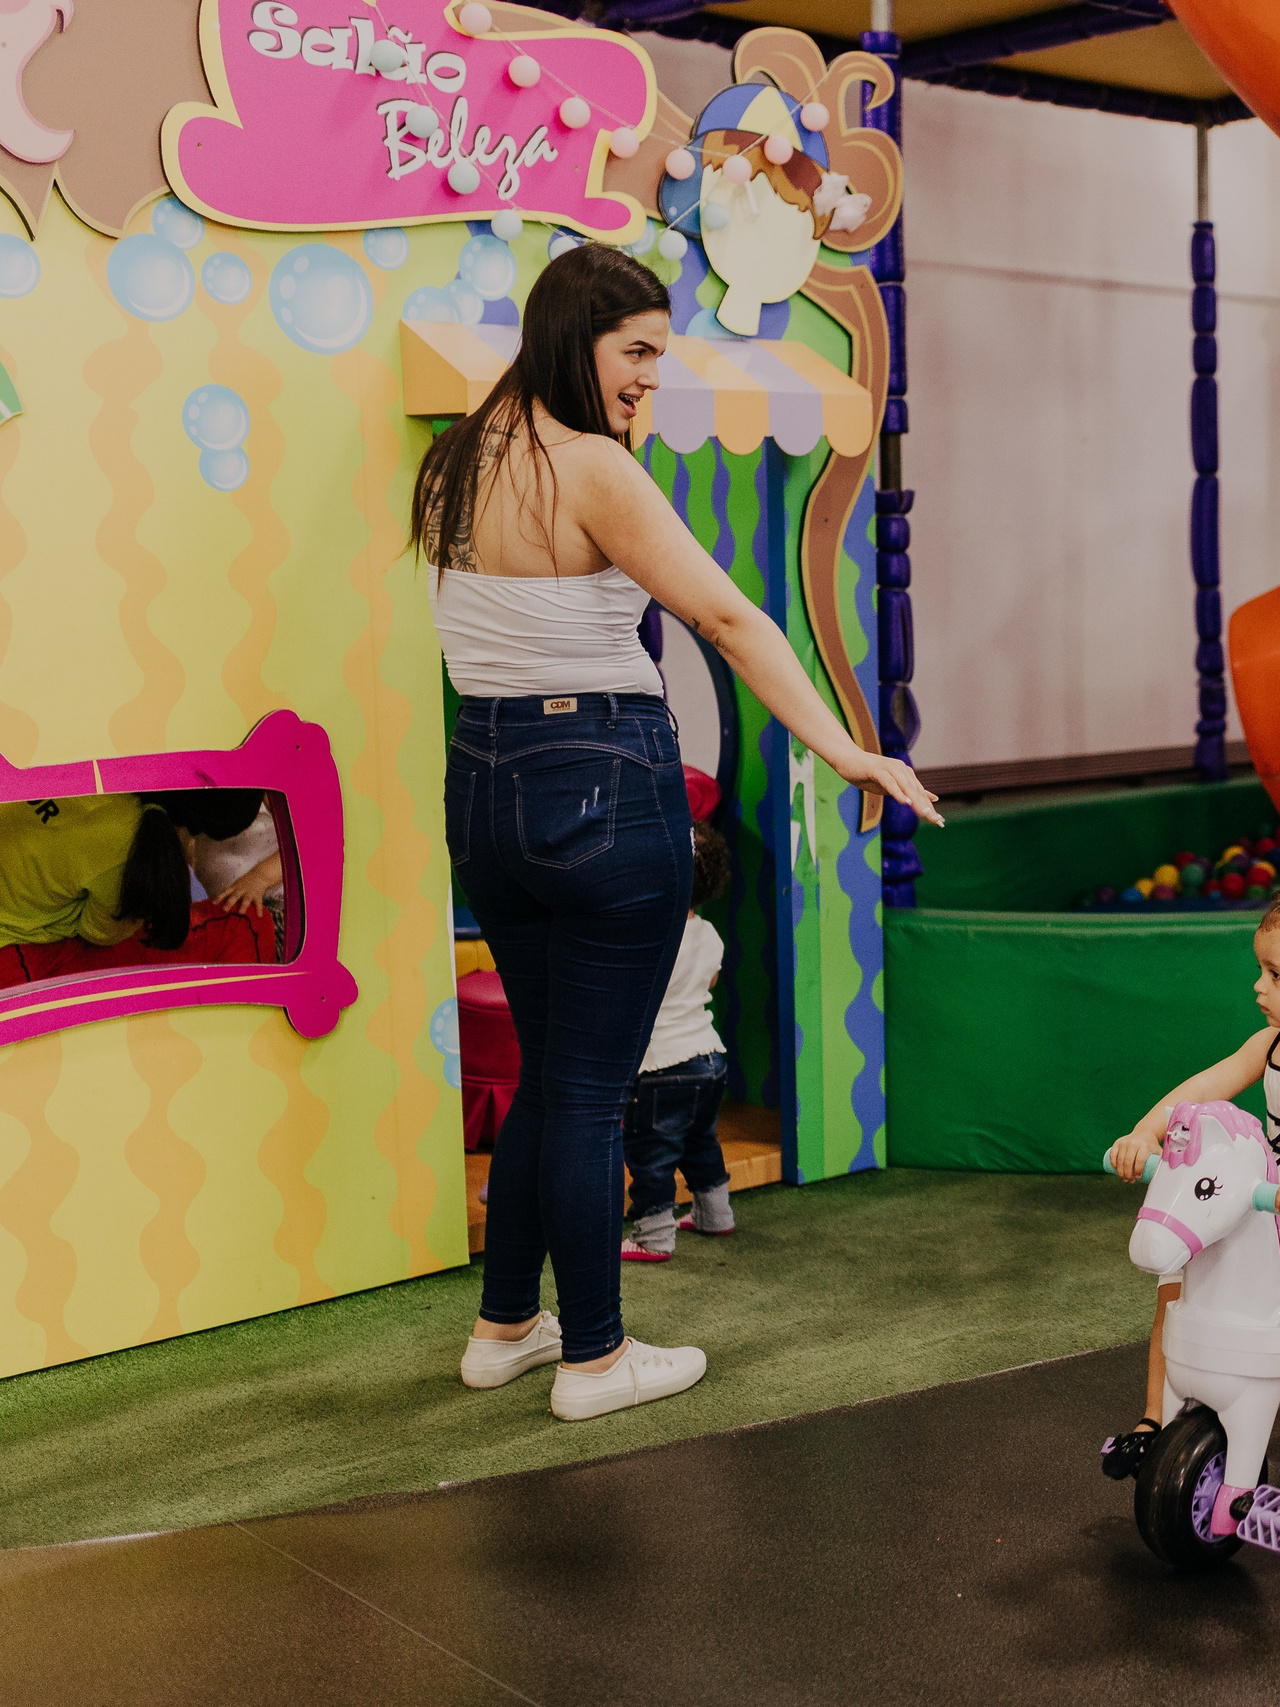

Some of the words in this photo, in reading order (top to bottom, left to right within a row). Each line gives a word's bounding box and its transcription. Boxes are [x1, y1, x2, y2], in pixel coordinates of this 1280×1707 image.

[247, 0, 467, 94] Salão
[376, 95, 558, 200] Beleza
[550, 700, 571, 709] CDM
